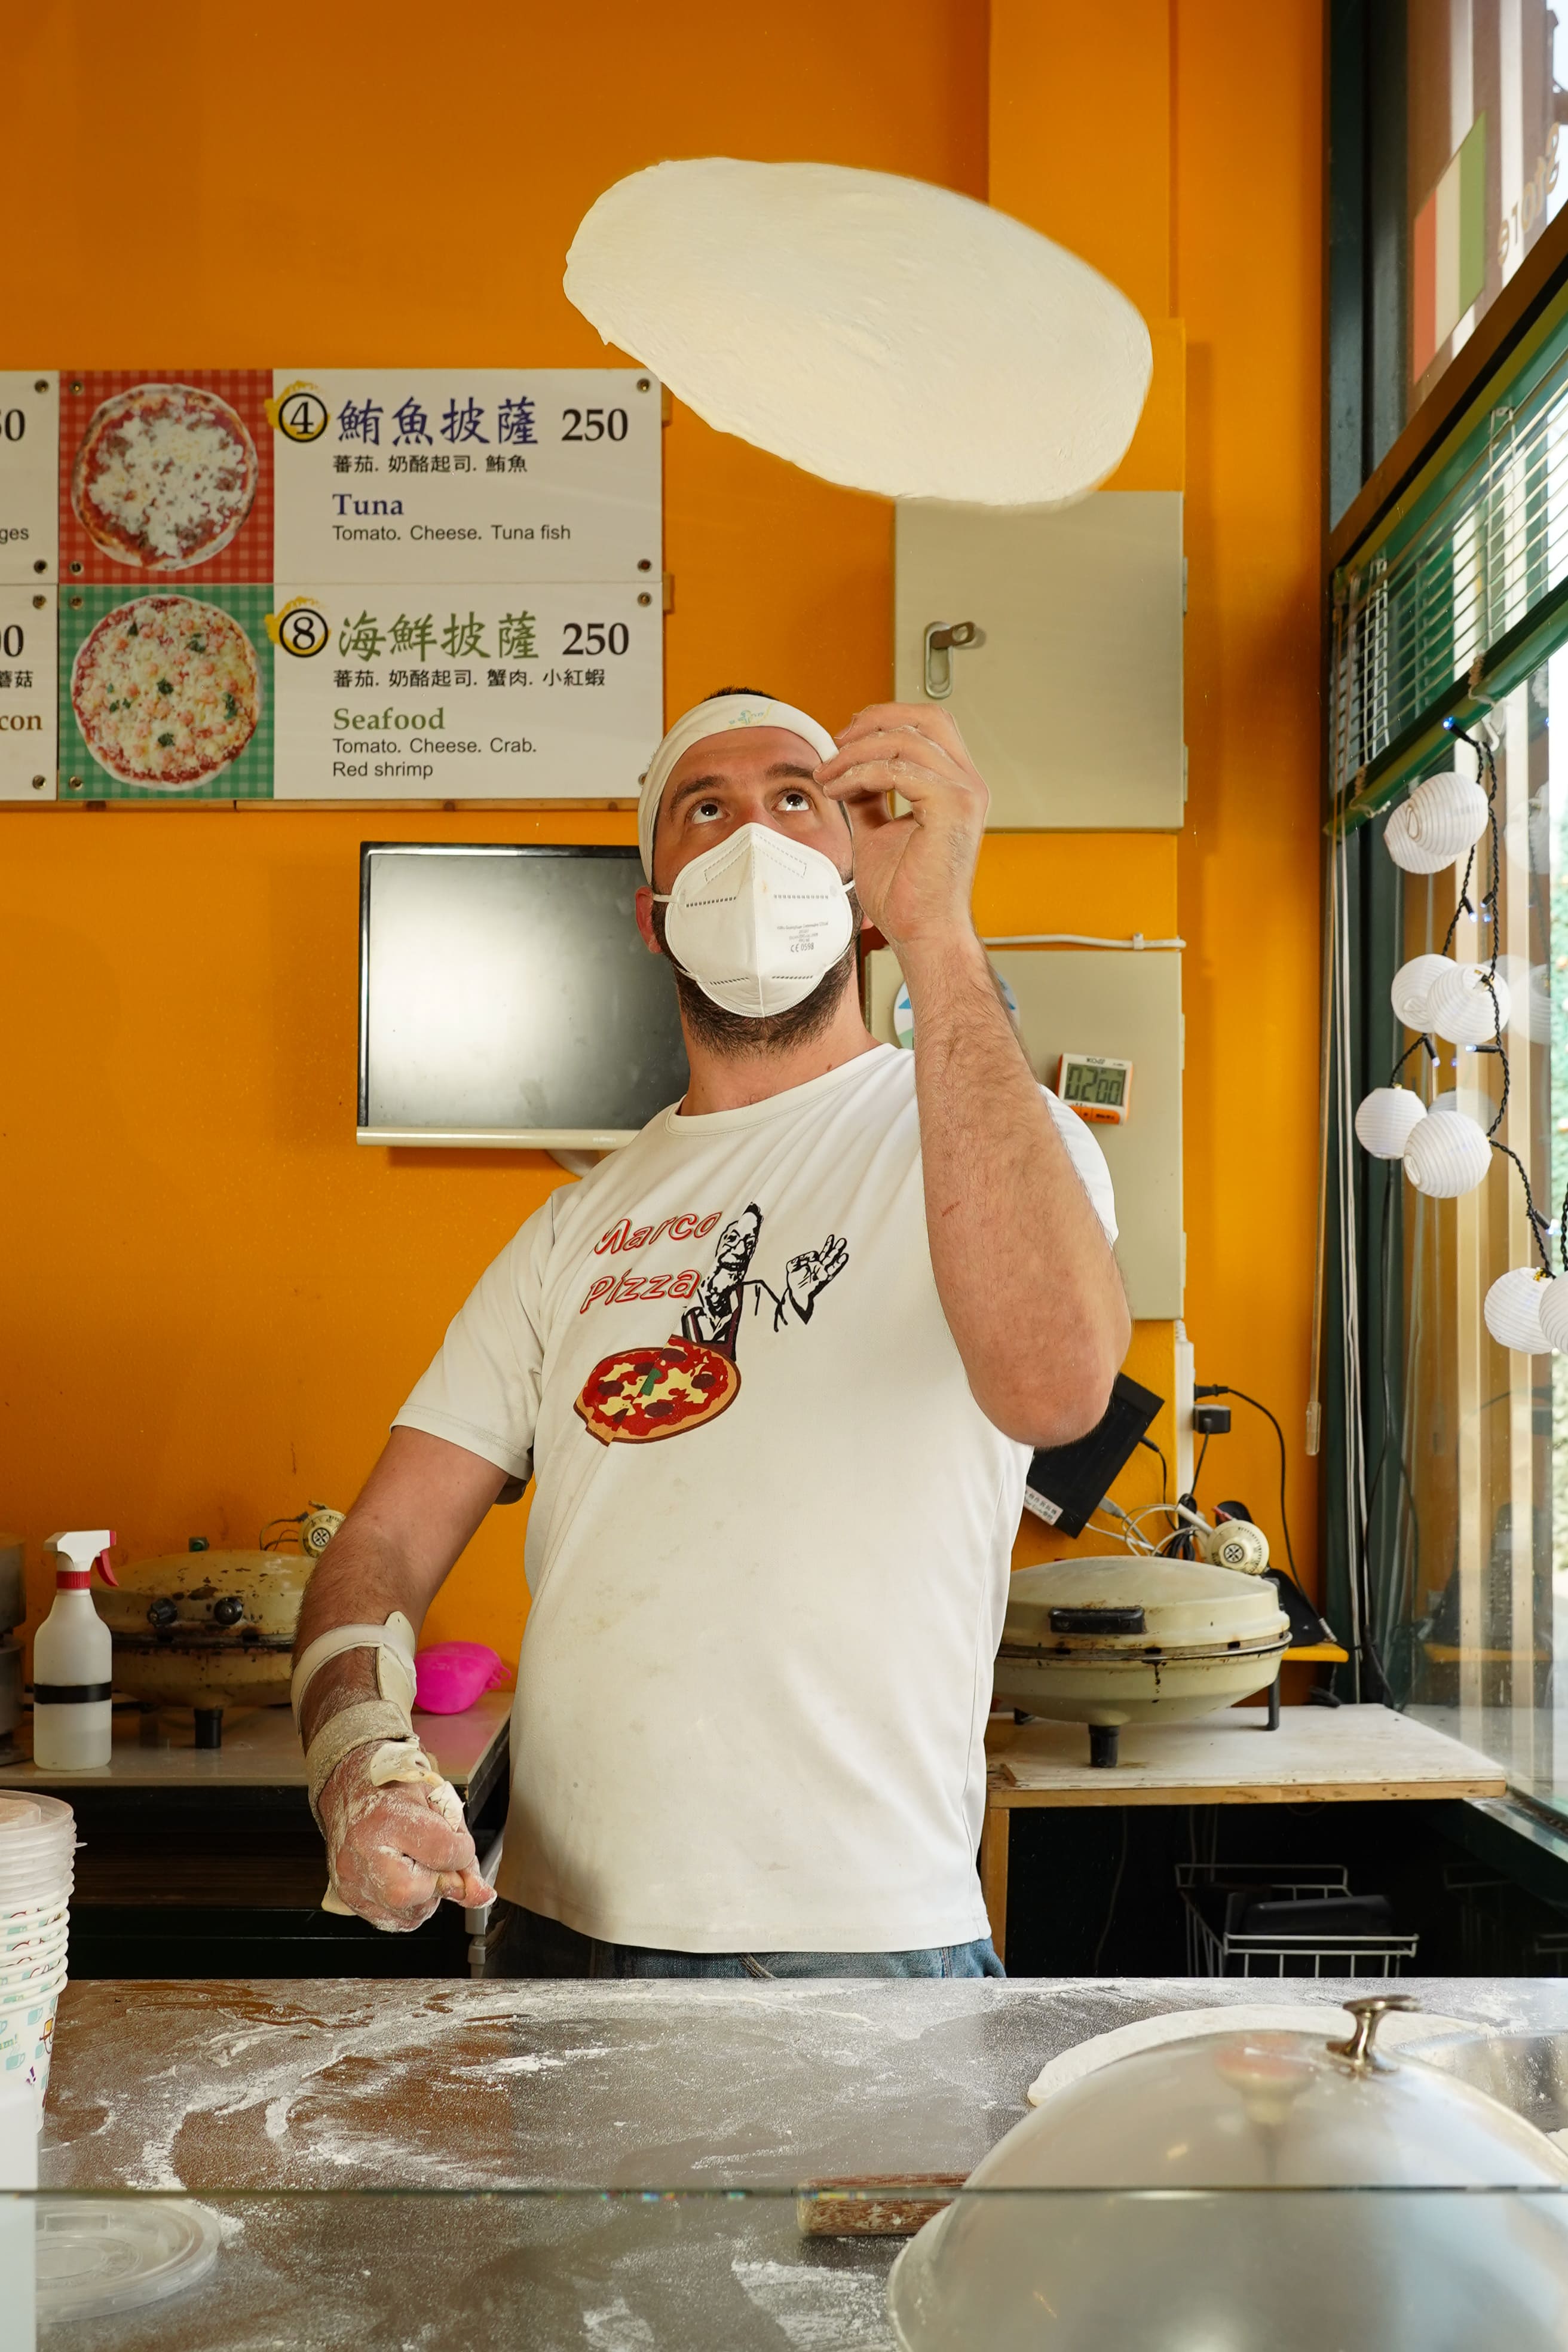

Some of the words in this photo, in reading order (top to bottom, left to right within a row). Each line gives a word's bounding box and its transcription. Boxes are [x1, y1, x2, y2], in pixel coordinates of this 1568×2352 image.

[0, 409, 26, 442] 0
[337, 396, 538, 446] 鮪魚披薩
[561, 409, 628, 442] 250
[485, 455, 528, 473] 鮪魚
[333, 494, 404, 516] Tuna
[332, 525, 401, 541] Tomato.
[410, 525, 482, 541] Cheese.
[491, 525, 535, 540] Tuna
[541, 525, 571, 540] fish
[0, 624, 24, 657] 0
[338, 610, 539, 662] 海鮮披薩
[562, 622, 629, 656] 250
[543, 668, 605, 687] 小紅蝦
[333, 706, 445, 730] Seafood
[332, 738, 401, 754] Tomato.
[409, 737, 482, 754] Cheese.
[490, 737, 537, 753] Crab.
[333, 761, 368, 777] Red
[374, 761, 433, 780] shrimp
